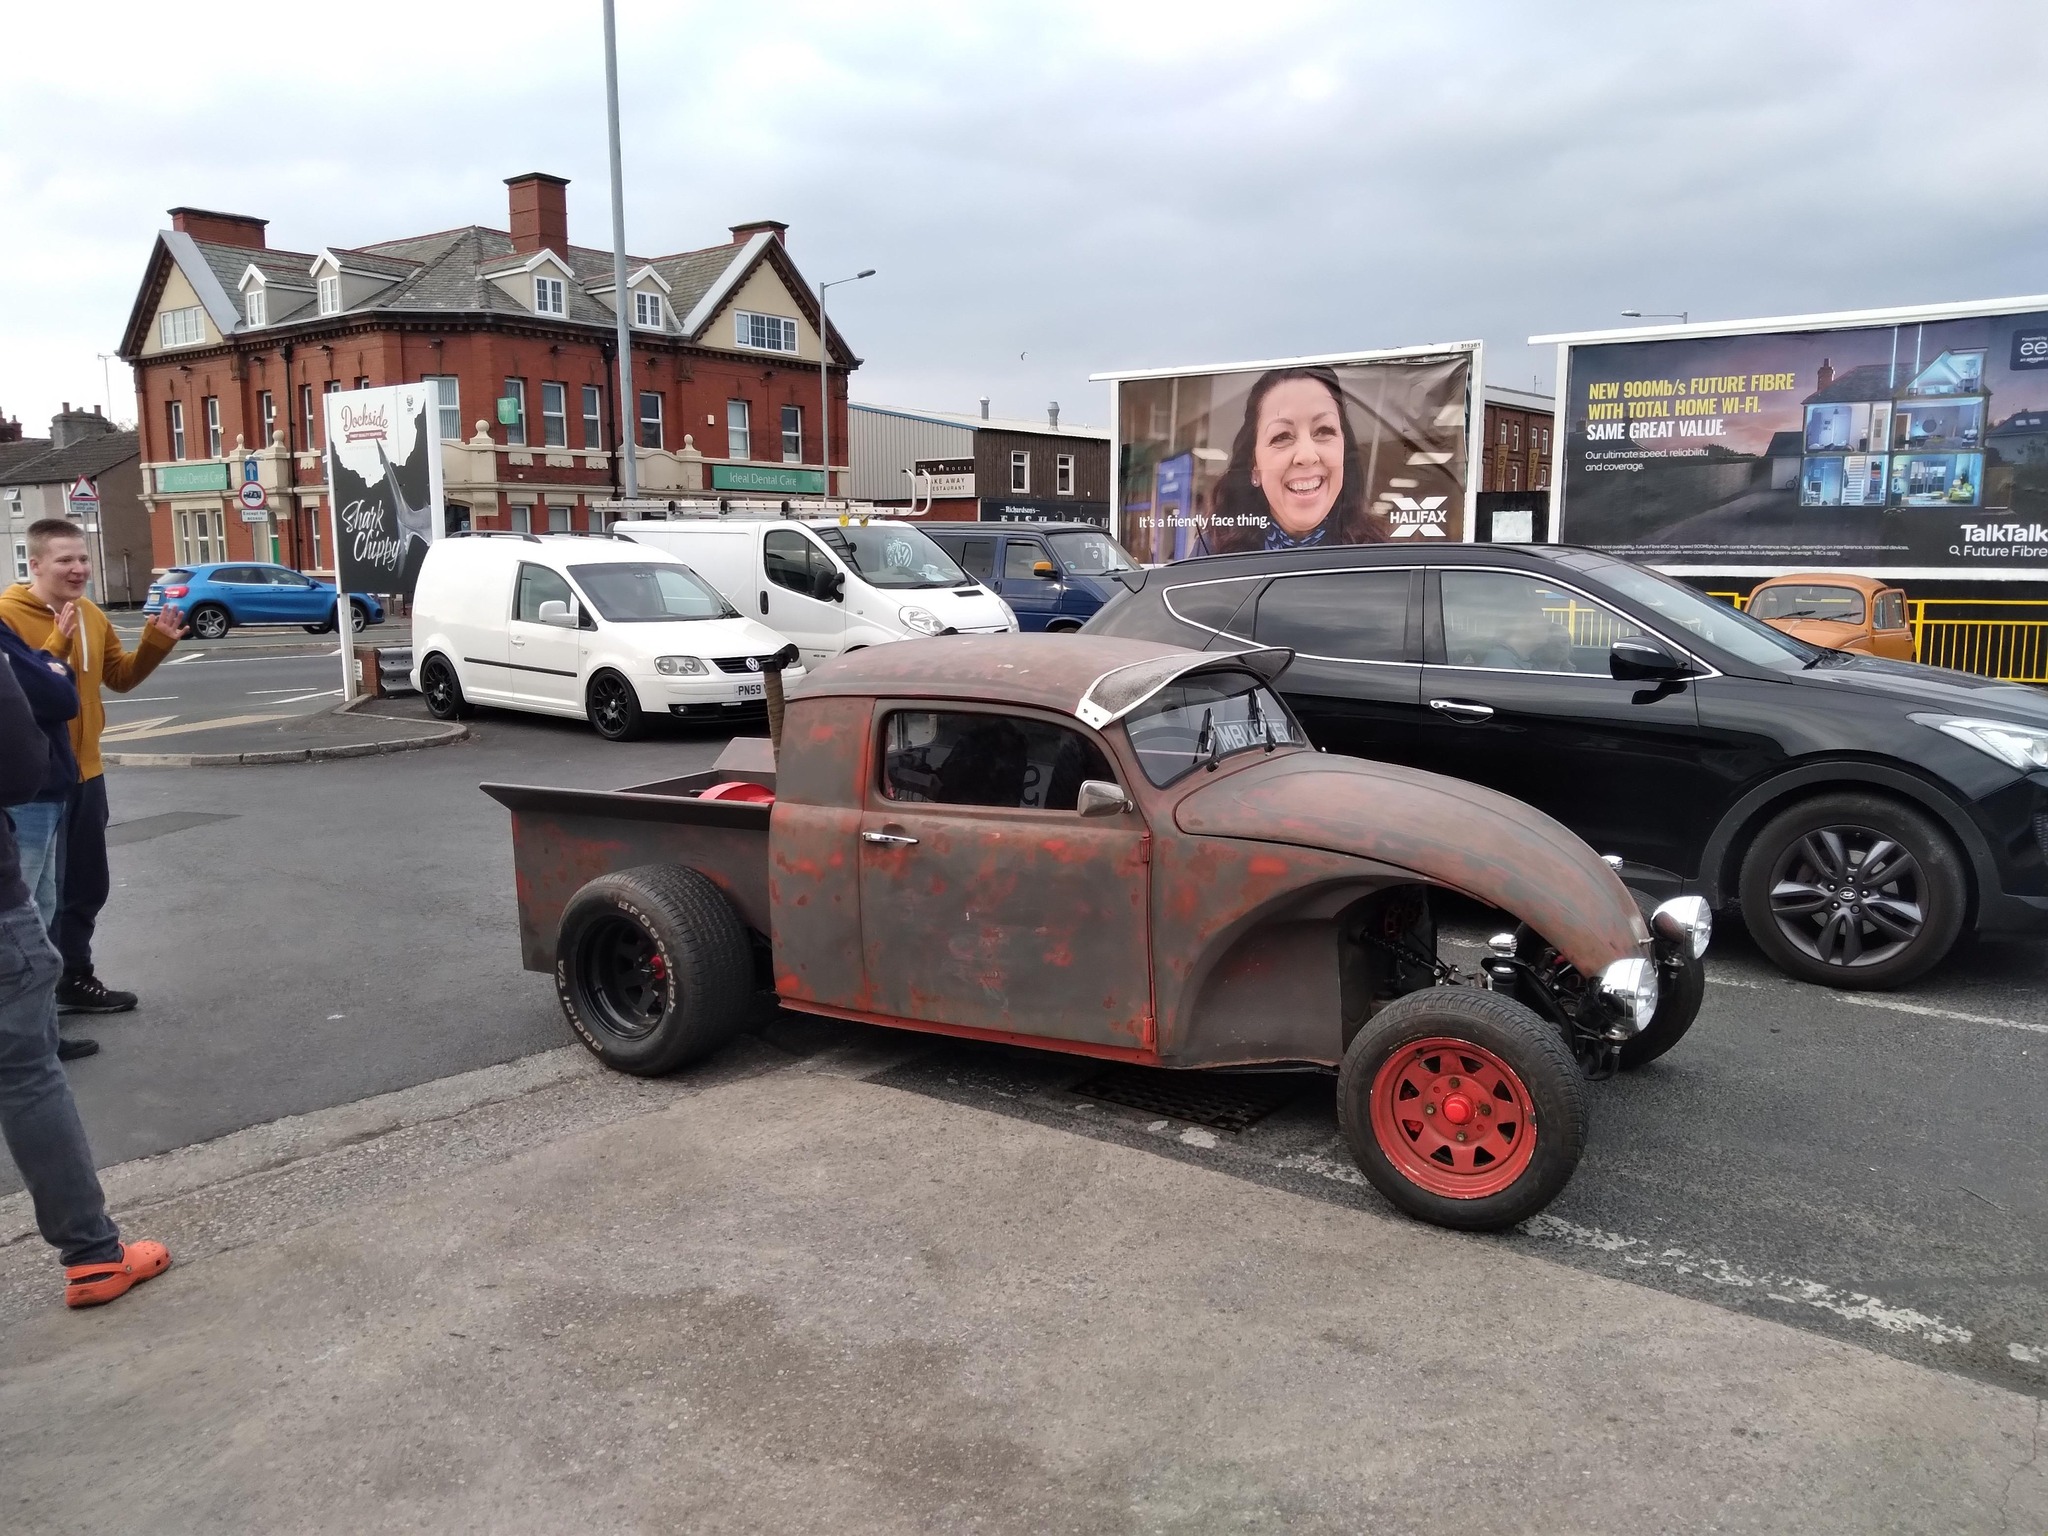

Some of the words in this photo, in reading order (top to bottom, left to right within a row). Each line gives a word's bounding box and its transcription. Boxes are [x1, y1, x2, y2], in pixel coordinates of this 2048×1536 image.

[1589, 382, 1619, 400] NEW
[1623, 378, 1686, 399] 900Mb/s
[1690, 376, 1747, 395] FUTURE
[1750, 373, 1796, 392] FIBRE
[1588, 402, 1624, 420] WITH
[1628, 400, 1670, 419] TOTAL
[1674, 398, 1717, 416] HOME
[1722, 396, 1761, 414] WI-FI.
[340, 403, 389, 432] Dockside
[1586, 423, 1626, 441] SAME
[1629, 420, 1675, 439] GREAT
[1679, 419, 1727, 437] VALUE.
[1585, 450, 1602, 460] Our
[1602, 450, 1639, 459] ultimate
[1669, 447, 1709, 458] reliability
[1585, 462, 1603, 472] and
[1603, 462, 1644, 472] coverage.
[210, 470, 224, 484] Care
[729, 472, 749, 484] Ideal
[751, 473, 777, 486] Dental
[779, 474, 797, 487] Care
[341, 499, 385, 533] Shark
[1139, 515, 1155, 528] It's
[1157, 518, 1165, 528] a
[1167, 514, 1209, 530] friendly
[1211, 514, 1234, 527] face
[1237, 513, 1271, 529] thing.
[1389, 510, 1448, 524] HALIFAX
[1960, 524, 2048, 542] TalkTalk
[353, 528, 401, 572] Chippy
[1963, 545, 2009, 557] Future
[2011, 545, 2048, 557] Fibre
[738, 684, 762, 696] PN59
